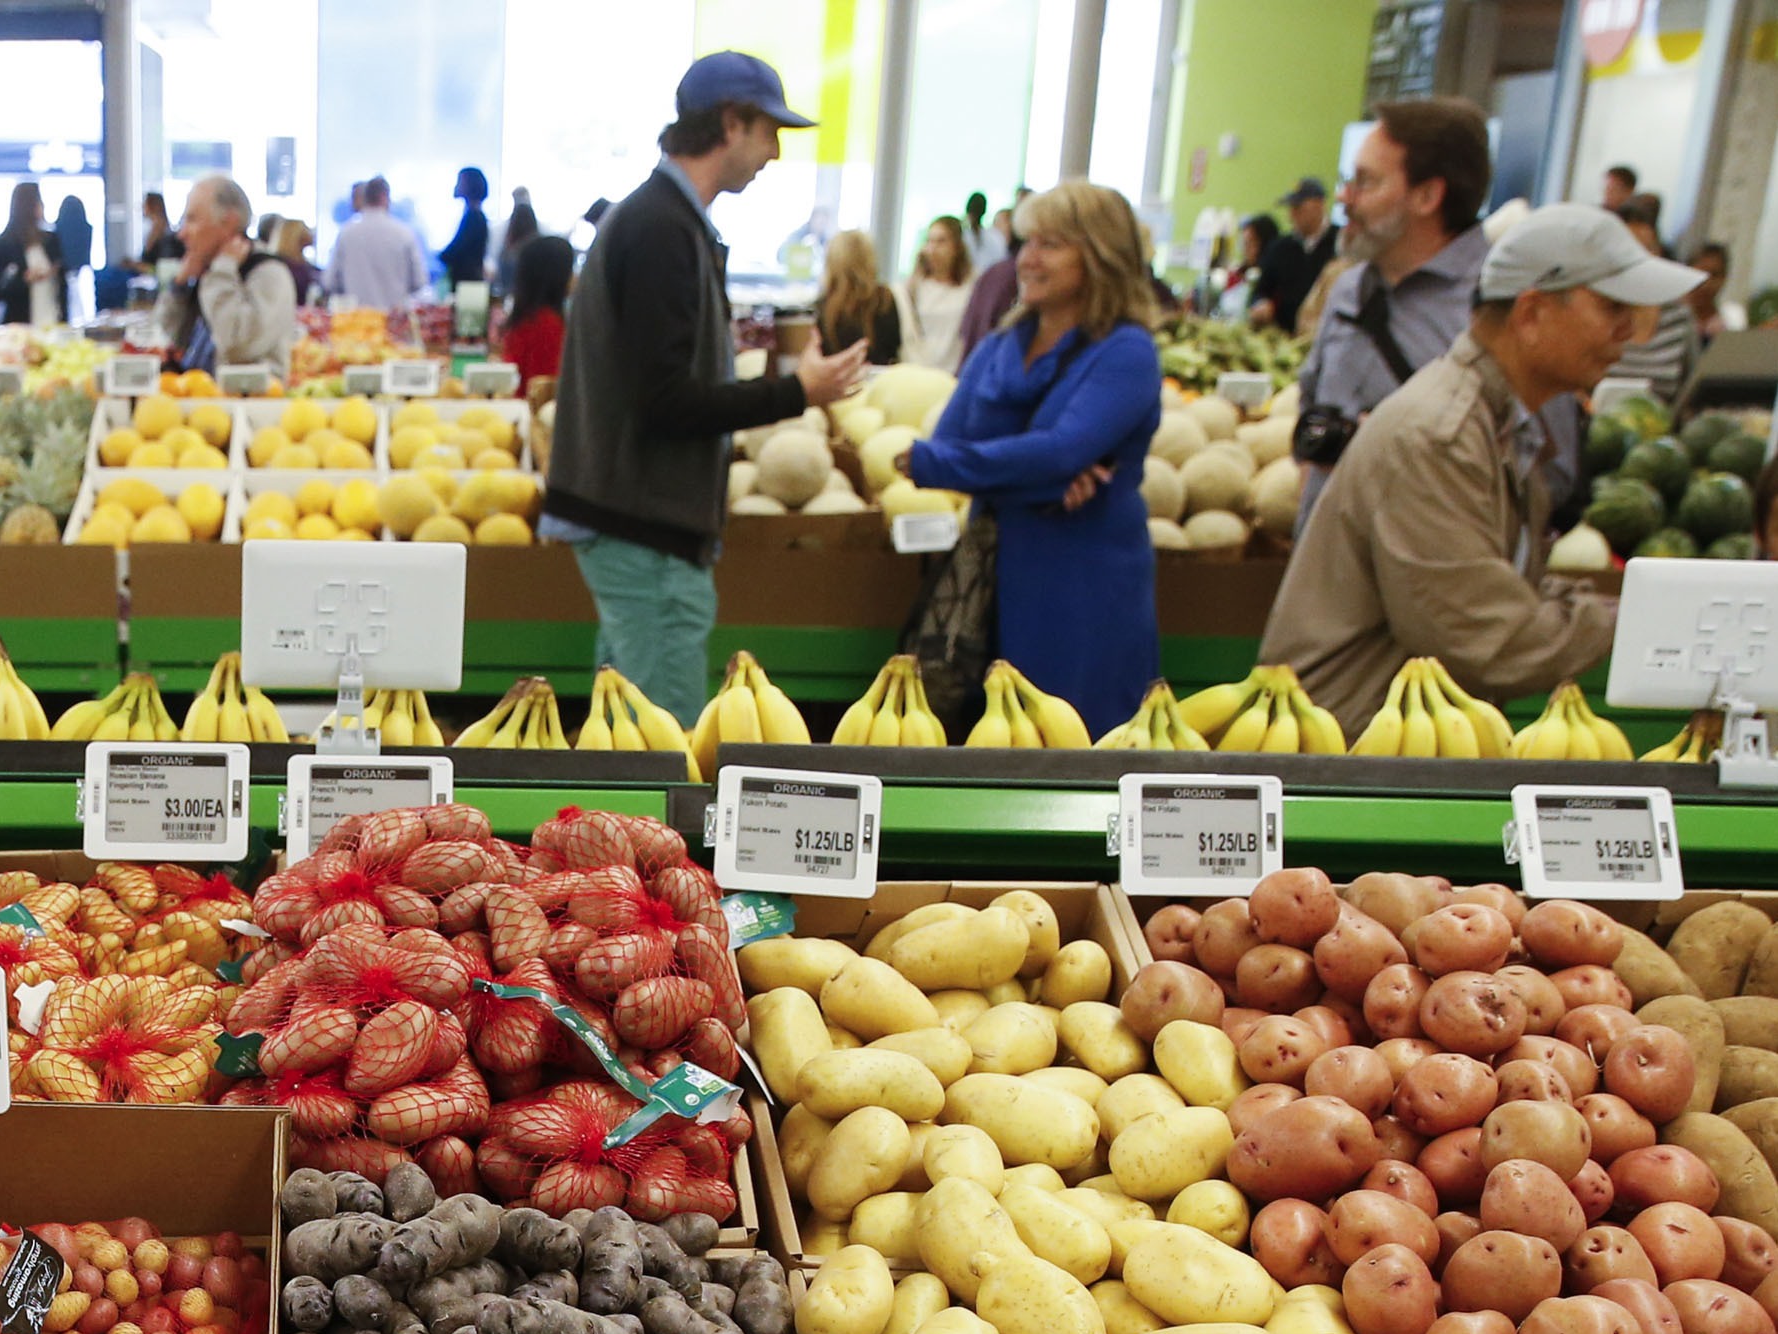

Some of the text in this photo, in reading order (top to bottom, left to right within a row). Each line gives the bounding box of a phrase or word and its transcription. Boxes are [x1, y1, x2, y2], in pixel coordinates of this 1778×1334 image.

[141, 756, 194, 766] ORGANIC
[343, 769, 396, 779] ORGANIC
[774, 784, 826, 796] ORGANIC
[1174, 789, 1226, 799] ORGANIC
[165, 798, 224, 818] $3.00/EA
[795, 828, 854, 852] $1.25/LB
[1198, 832, 1257, 852] $1.25/LB
[1595, 840, 1654, 858] $1.25/LB
